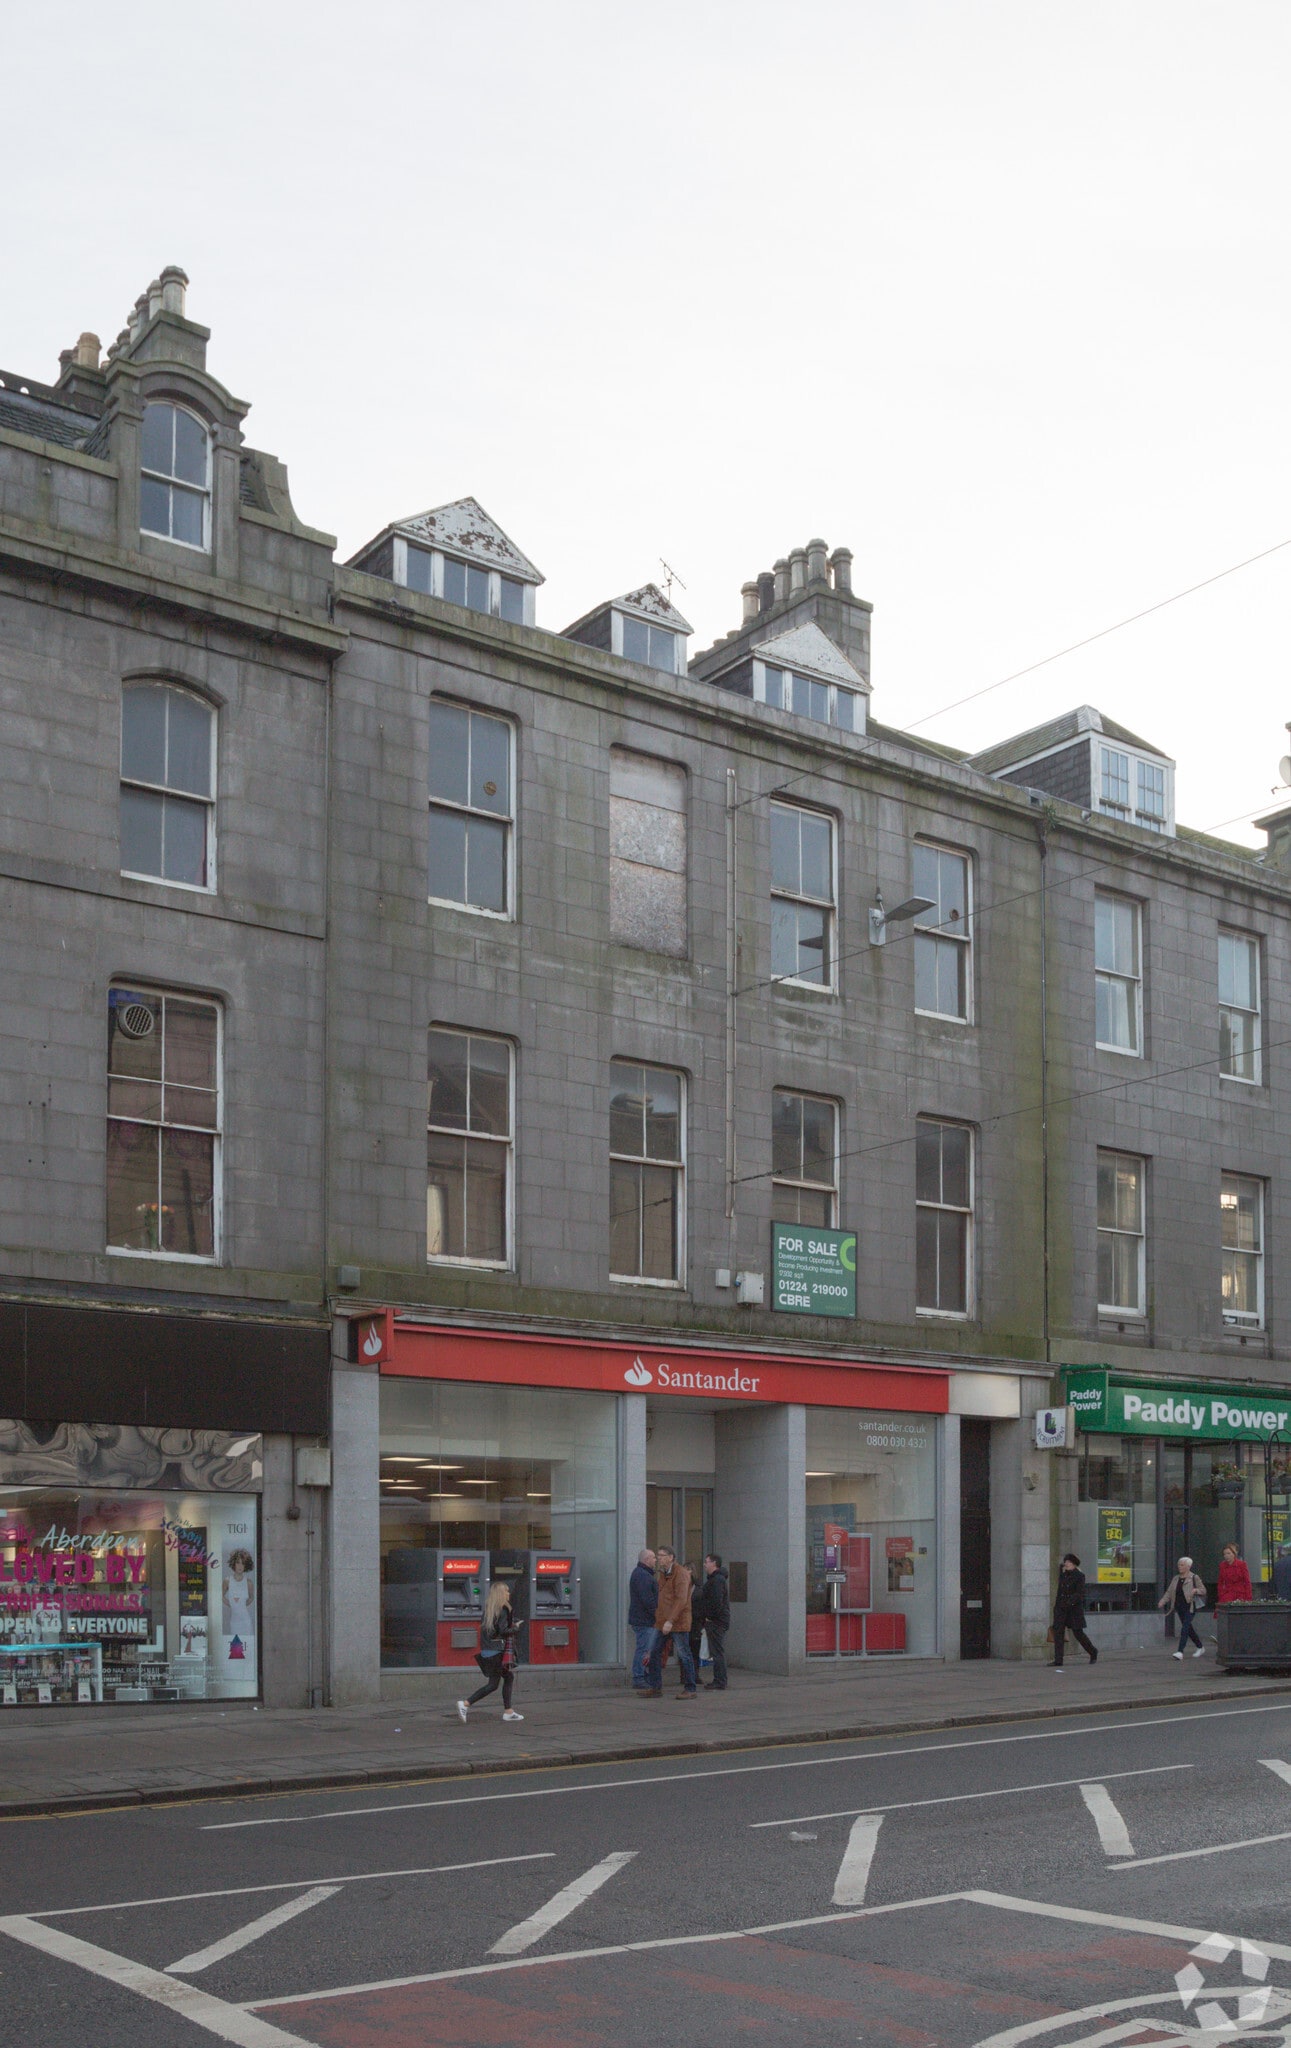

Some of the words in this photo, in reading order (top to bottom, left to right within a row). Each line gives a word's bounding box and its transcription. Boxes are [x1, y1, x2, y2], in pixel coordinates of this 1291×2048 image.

[778, 1237, 803, 1252] FOR
[807, 1240, 837, 1256] SALE
[778, 1252, 808, 1261] Development
[808, 1255, 835, 1266] Opportunity
[778, 1261, 796, 1270] Income
[796, 1263, 819, 1273] Producing
[819, 1266, 843, 1275] Investment
[779, 1280, 807, 1292] 01224
[812, 1283, 848, 1297] 219000
[779, 1293, 810, 1308] CBRE
[657, 1363, 760, 1393] Santander
[1070, 1389, 1102, 1401] Paddy
[1070, 1401, 1102, 1411] Power
[1123, 1394, 1206, 1430] Paddy
[1211, 1401, 1288, 1430] Power
[858, 1422, 927, 1434] santander.co.uk
[866, 1435, 889, 1446] 0800
[890, 1436, 906, 1447] 030
[908, 1438, 927, 1449] 4321
[40, 1523, 140, 1549] Aberdeen
[0, 1553, 95, 1583] LOVED
[106, 1554, 145, 1584] BY
[40, 1617, 61, 1633] TO
[67, 1617, 148, 1634] EVERYONE
